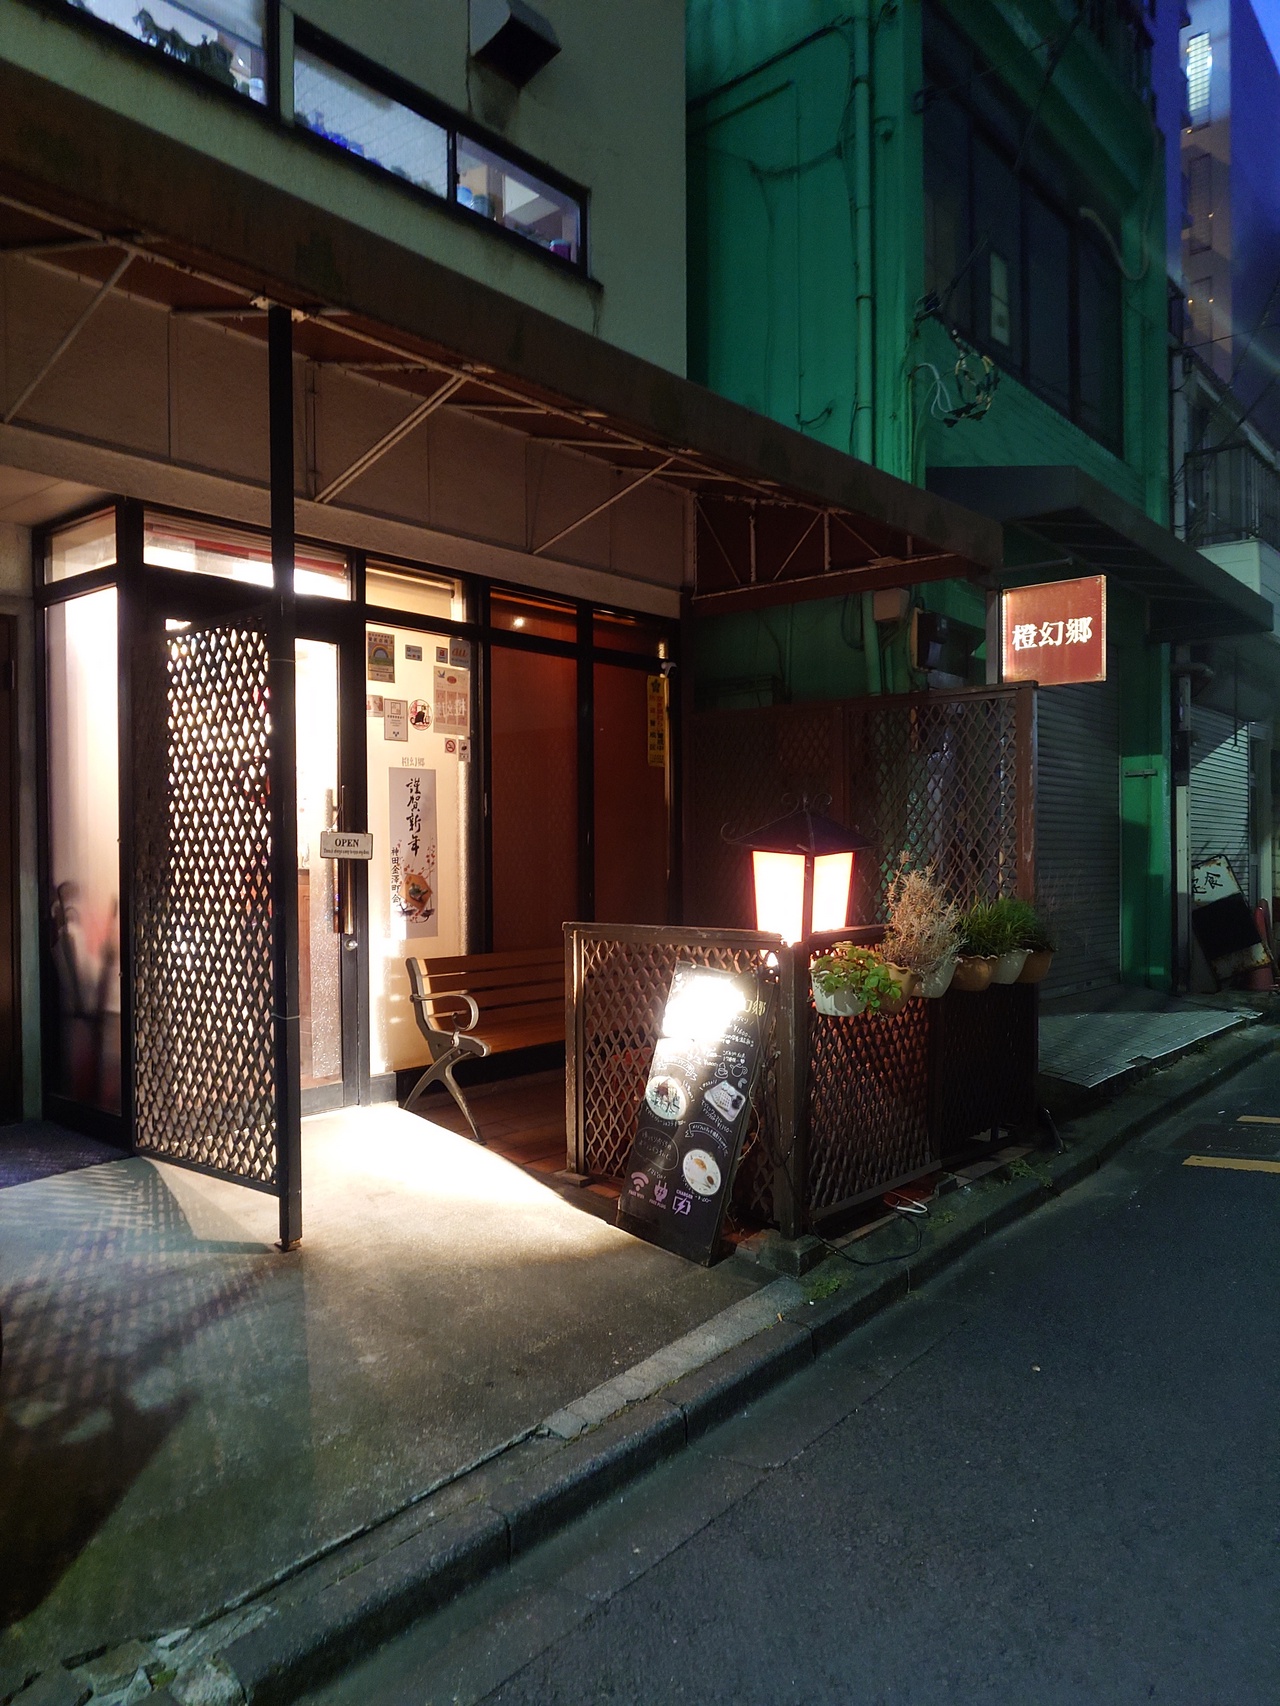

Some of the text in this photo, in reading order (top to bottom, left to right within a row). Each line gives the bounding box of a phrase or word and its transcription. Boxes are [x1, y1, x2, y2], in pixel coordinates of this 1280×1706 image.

[1011, 616, 1093, 651] 橙幻郷
[452, 647, 467, 657] au
[405, 777, 422, 857] 謹賀新年
[334, 837, 359, 848] OPEN
[675, 1188, 694, 1199] CHARGER
